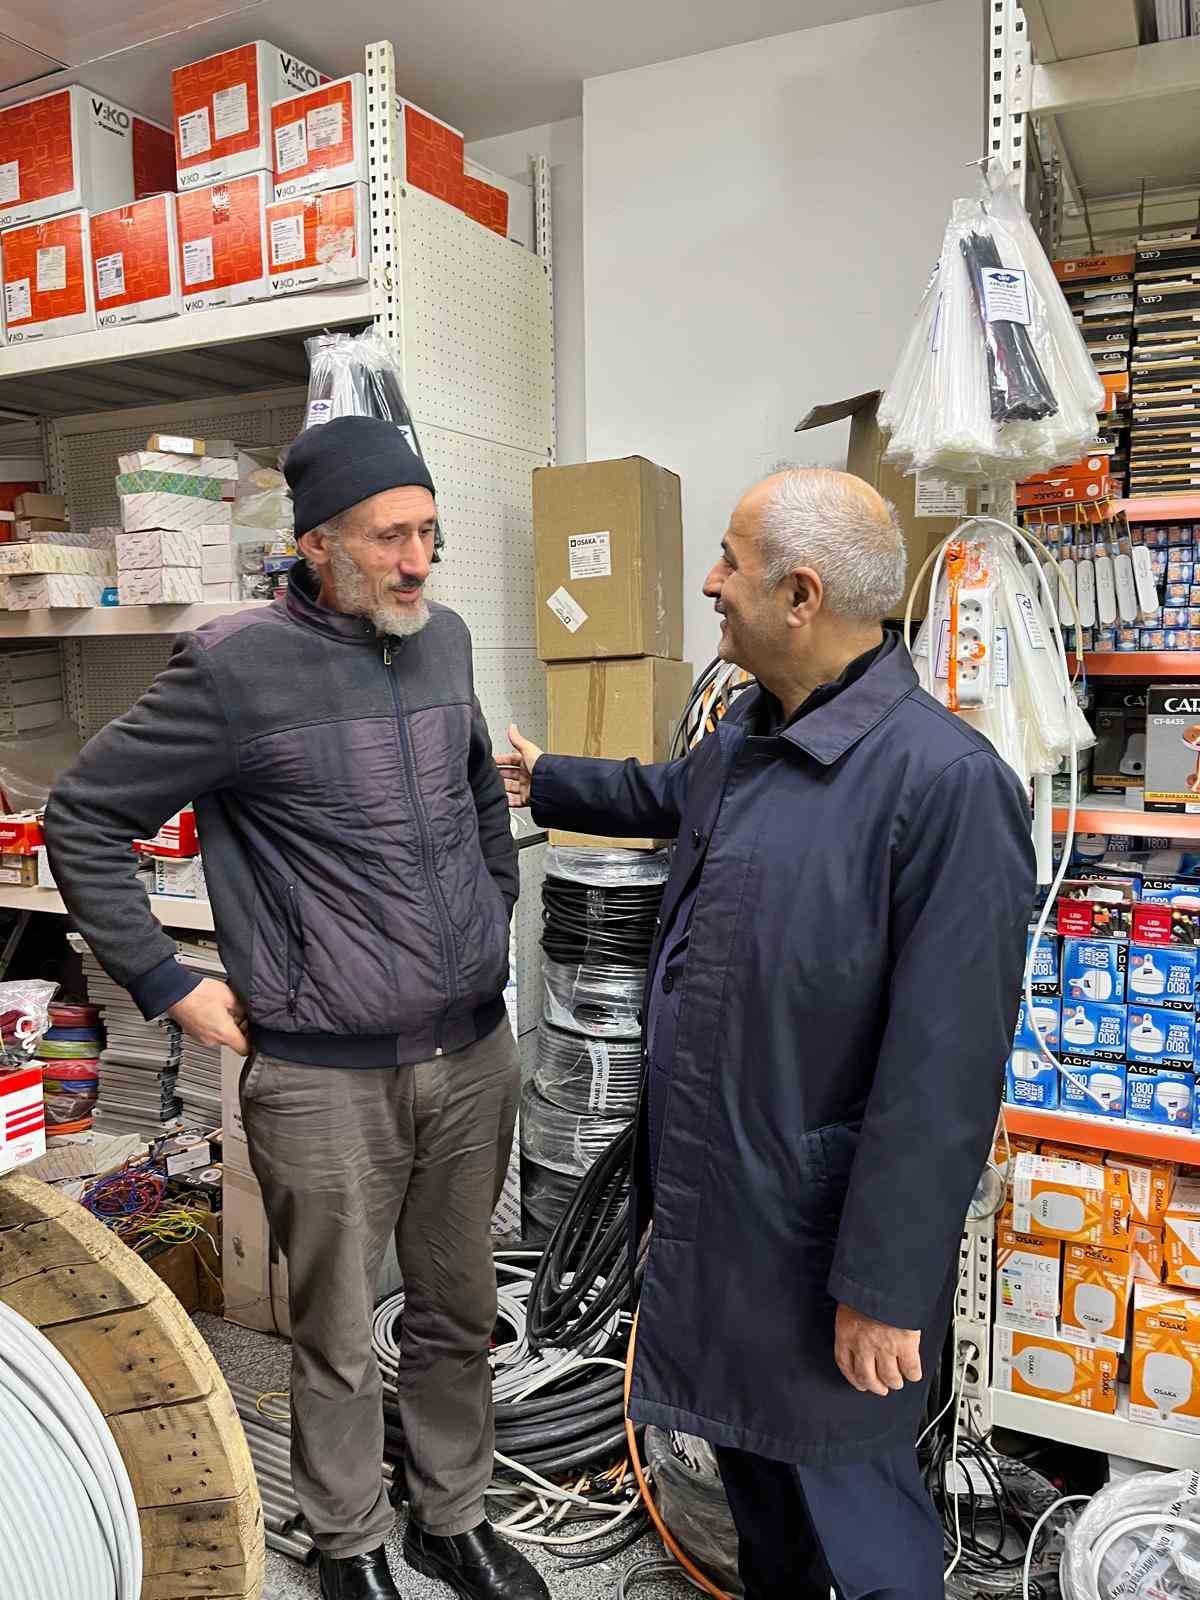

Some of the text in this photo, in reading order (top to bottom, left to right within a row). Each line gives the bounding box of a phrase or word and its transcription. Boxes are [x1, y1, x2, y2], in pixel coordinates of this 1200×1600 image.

[577, 538, 596, 546] OSAKA
[1164, 697, 1200, 713] CAT
[1143, 881, 1172, 889] ACK
[1118, 945, 1126, 972] ACK
[1167, 982, 1191, 995] 1800
[1164, 1000, 1193, 1010] ACK
[1098, 1032, 1120, 1044] 1800
[1166, 1040, 1190, 1053] 1800
[1095, 1051, 1124, 1060] ACK
[1063, 1057, 1090, 1066] ACK
[1163, 1060, 1192, 1069] ACK
[1128, 1065, 1158, 1074] ACK
[1131, 1081, 1153, 1095] 1800
[1112, 1209, 1120, 1236] OSAKA
[1159, 1319, 1189, 1332] OSAKA
[1153, 1388, 1177, 1398] OSAKA
